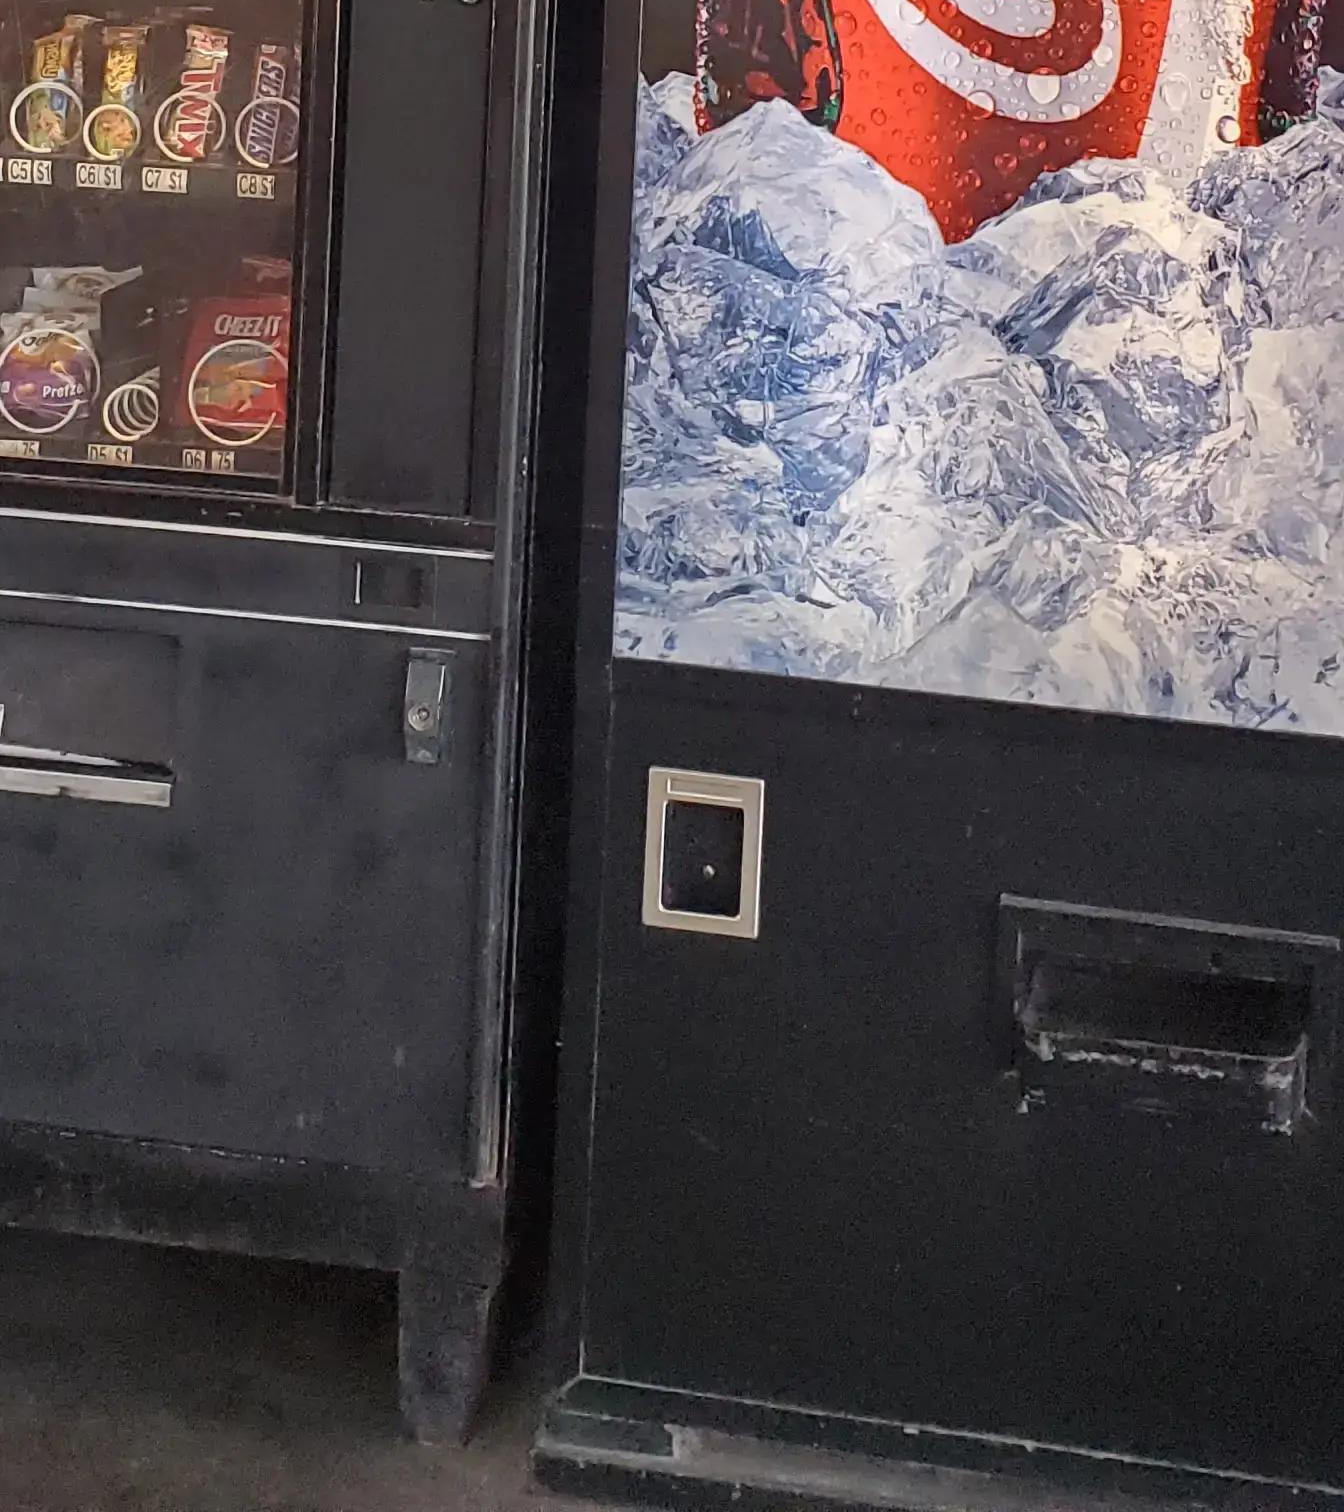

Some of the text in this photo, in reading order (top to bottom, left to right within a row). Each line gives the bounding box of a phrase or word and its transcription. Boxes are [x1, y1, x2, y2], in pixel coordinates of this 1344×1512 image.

[176, 61, 227, 158] TWIX
[246, 58, 286, 162] SNICKERS
[10, 160, 29, 180] C5
[78, 165, 96, 184] C6
[145, 169, 162, 188] C7
[239, 175, 256, 194] C8
[214, 313, 282, 337] CHEEZ-IT
[42, 384, 85, 400] Pretze
[185, 451, 202, 469] D6
